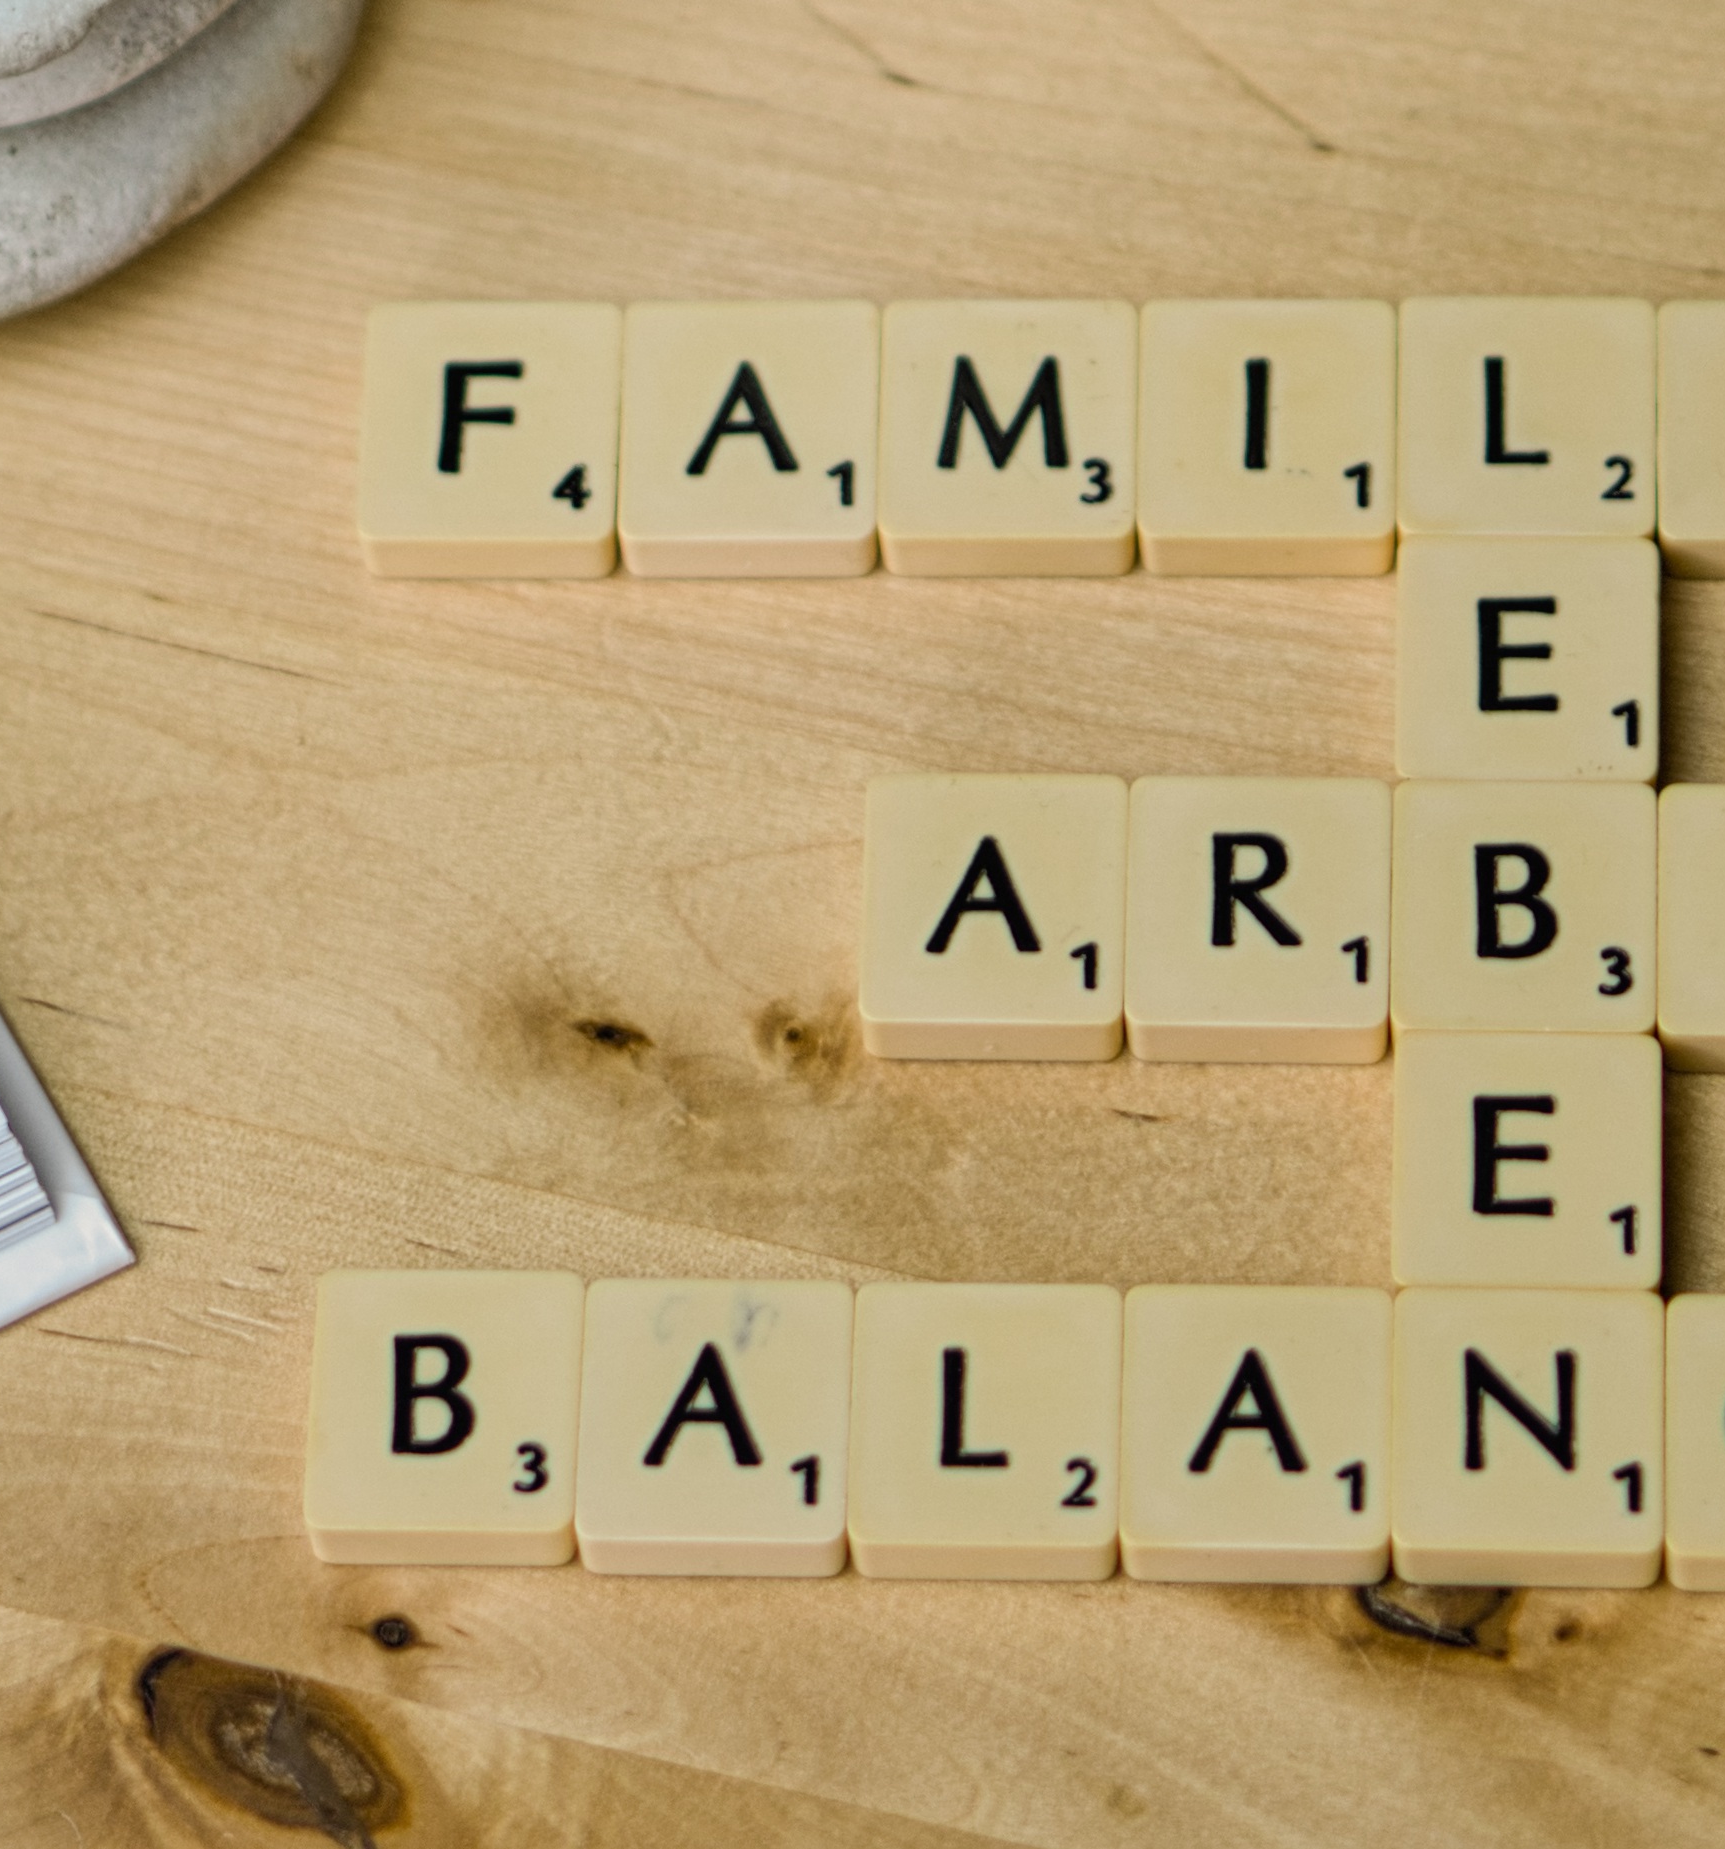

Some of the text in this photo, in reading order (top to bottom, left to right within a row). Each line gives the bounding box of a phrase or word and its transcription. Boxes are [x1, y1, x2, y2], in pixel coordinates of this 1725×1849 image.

[552, 466, 590, 510] 4
[827, 461, 854, 506] 1
[1080, 458, 1113, 504] 3
[1344, 463, 1370, 509] 1
[1601, 456, 1634, 500] 2
[1612, 700, 1640, 748] 1
[1070, 942, 1098, 990] 1
[1341, 936, 1369, 984] 1
[1598, 946, 1634, 997] 3
[1609, 1205, 1637, 1255] 1
[513, 1443, 548, 1493] 3
[790, 1456, 820, 1506] 1
[1061, 1458, 1097, 1508] 2
[1336, 1462, 1365, 1512] 1
[1613, 1462, 1643, 1514] 1
